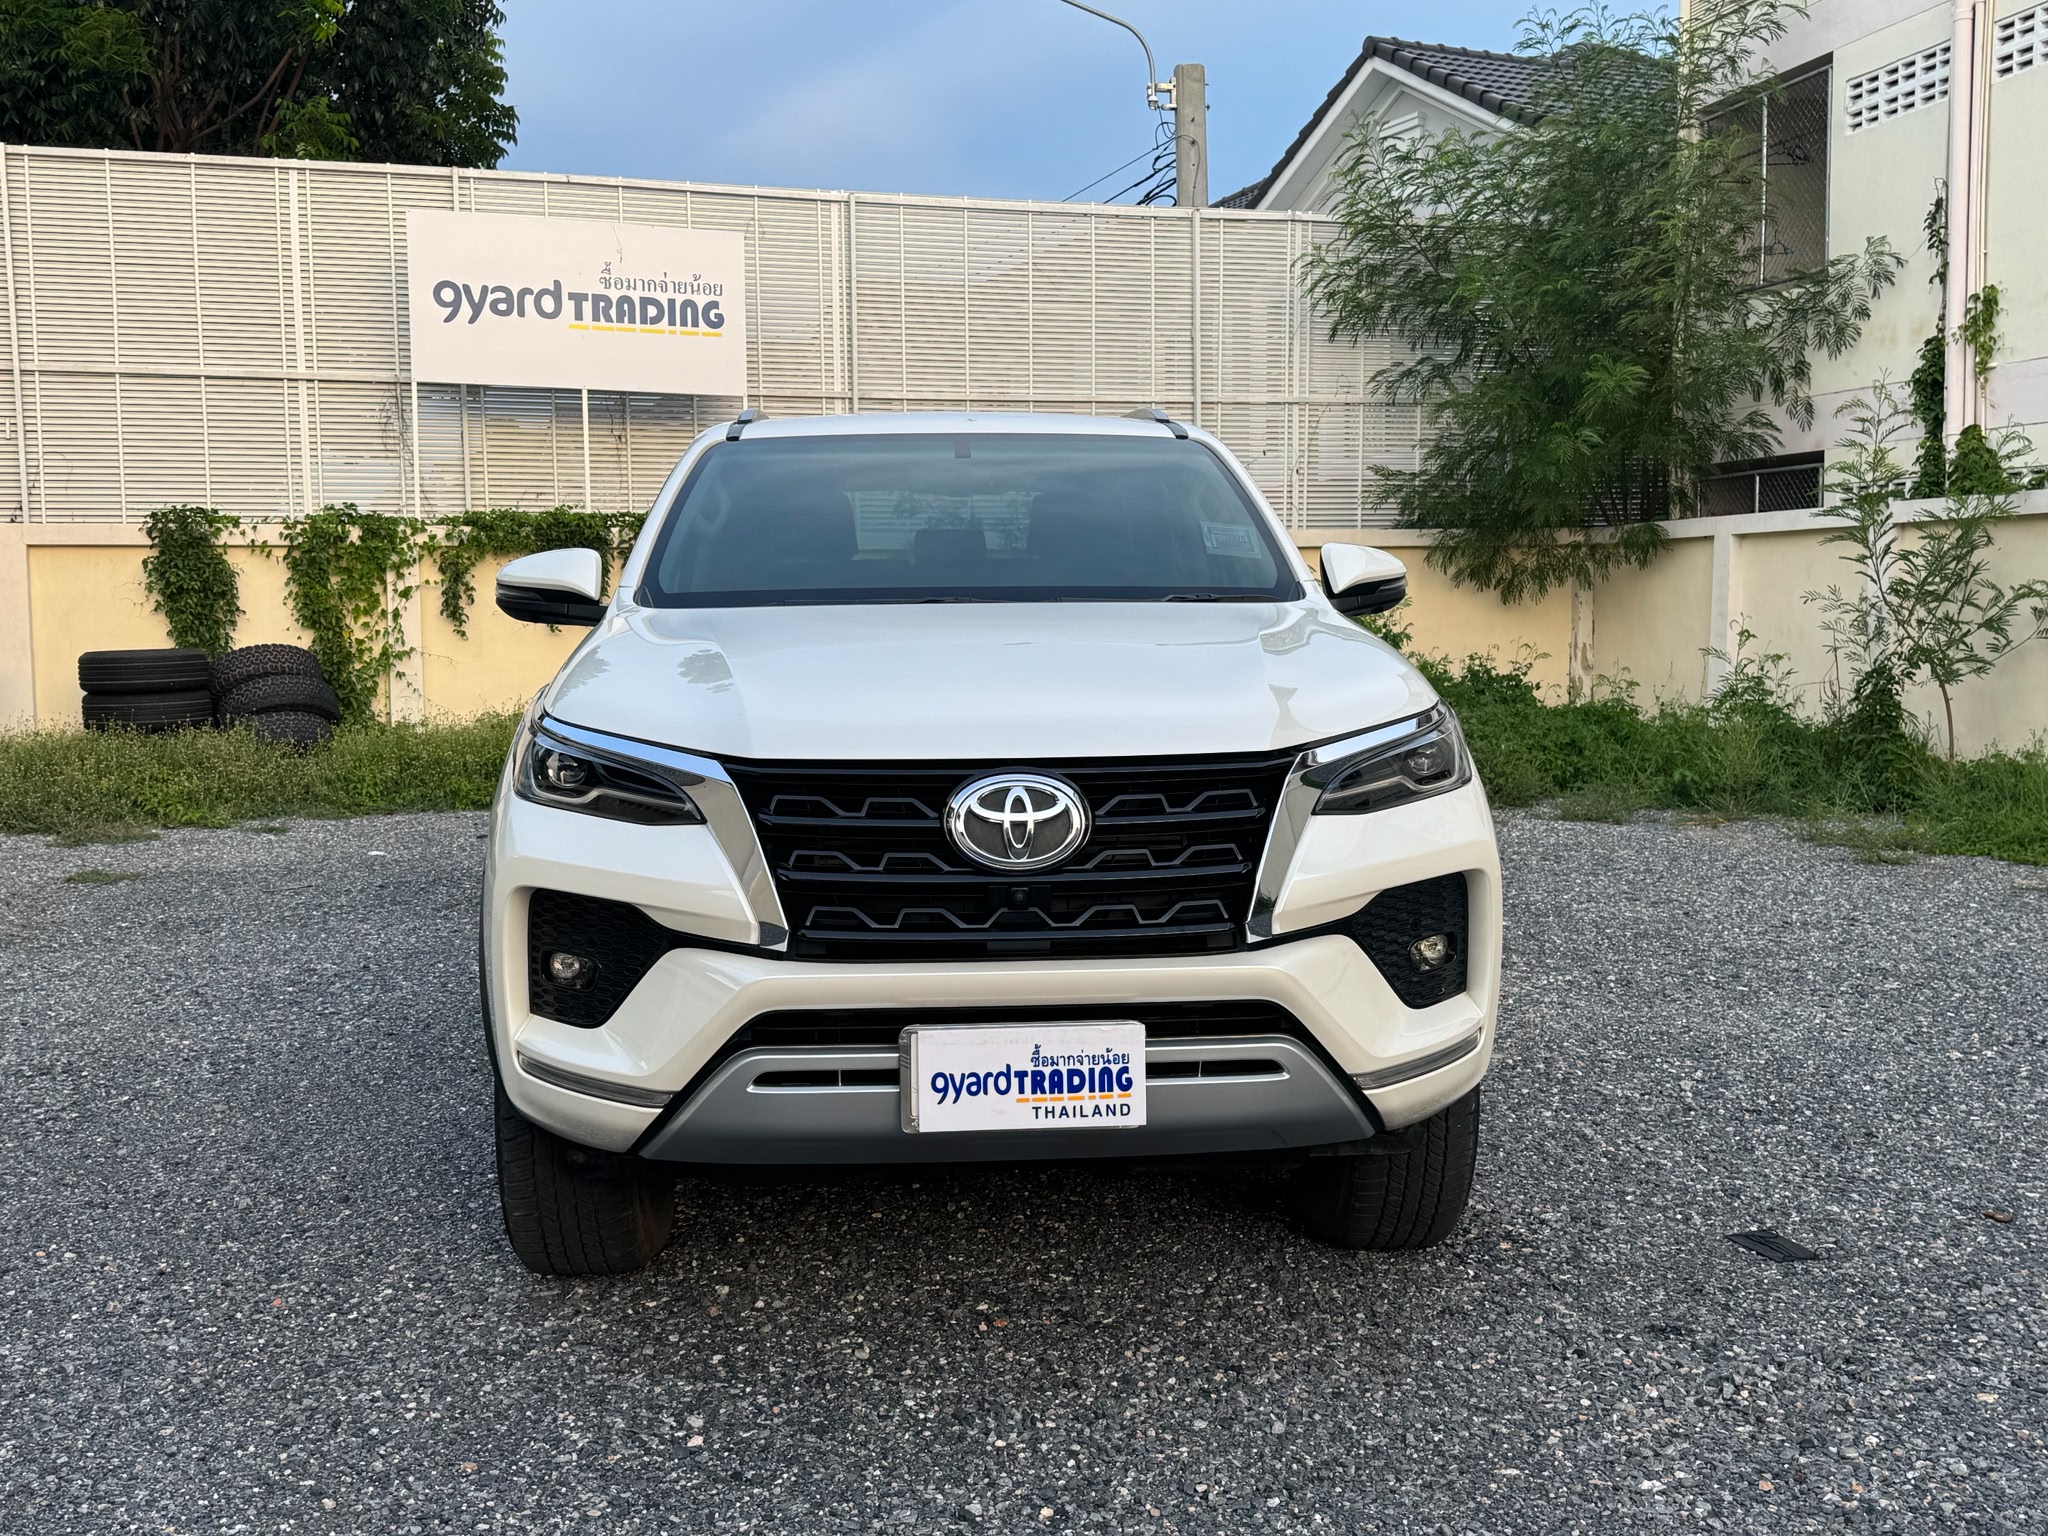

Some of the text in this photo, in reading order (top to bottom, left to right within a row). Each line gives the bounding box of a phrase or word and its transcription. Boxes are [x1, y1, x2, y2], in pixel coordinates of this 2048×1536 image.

[599, 261, 723, 297] ซื้อมากจ่ายน้อย
[1030, 1043, 1130, 1067] ซื้อมากจ่ายน้อย
[1032, 1103, 1131, 1119] THAILAND
